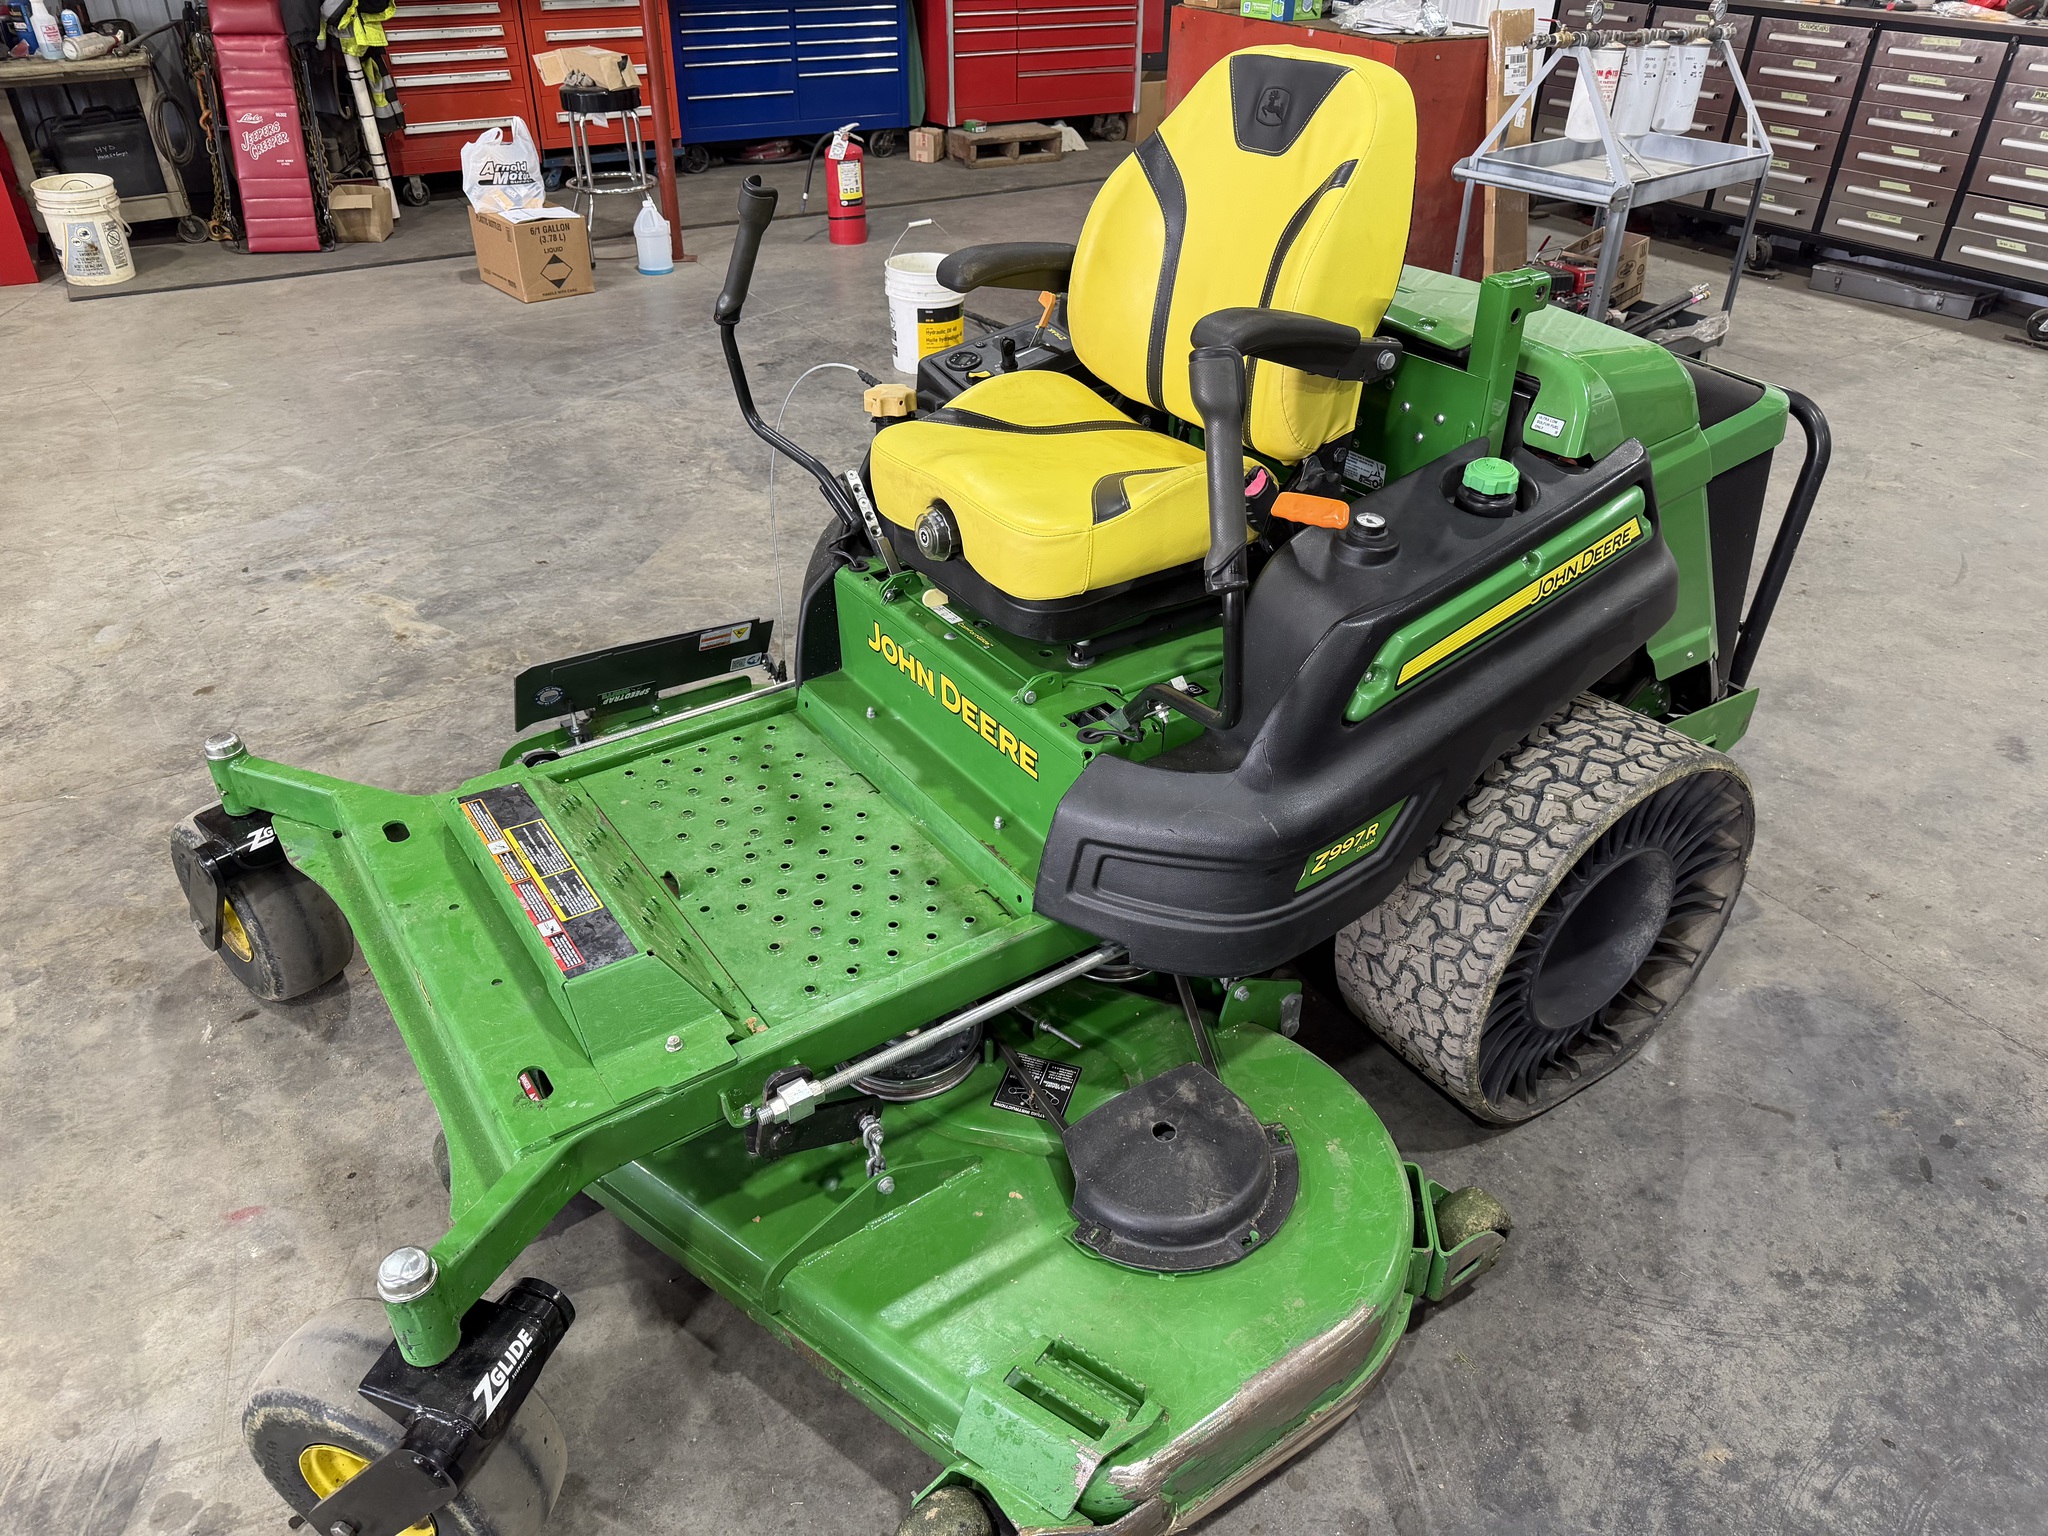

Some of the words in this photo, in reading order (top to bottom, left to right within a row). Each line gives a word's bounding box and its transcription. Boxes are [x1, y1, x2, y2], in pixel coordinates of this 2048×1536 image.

[241, 121, 280, 151] JEEPERS
[250, 132, 289, 160] CREEPER
[479, 161, 527, 176] Arnold
[530, 226, 541, 235] 6/1
[543, 222, 570, 234] GALLON
[539, 235, 557, 245] (3.78
[558, 233, 566, 242] L)
[544, 246, 563, 254] LIQUID
[1530, 561, 1578, 605] JOHN
[1580, 526, 1632, 573] DEERE
[868, 620, 936, 699] JOHN
[940, 672, 1039, 782] DEERE
[1311, 822, 1379, 875] Z997R
[1356, 837, 1376, 852] Diesel
[993, 1101, 1031, 1115] INSTRUCTIONS
[472, 1328, 533, 1421] ZGLIDE
[512, 1349, 533, 1379] SUSPENSION
